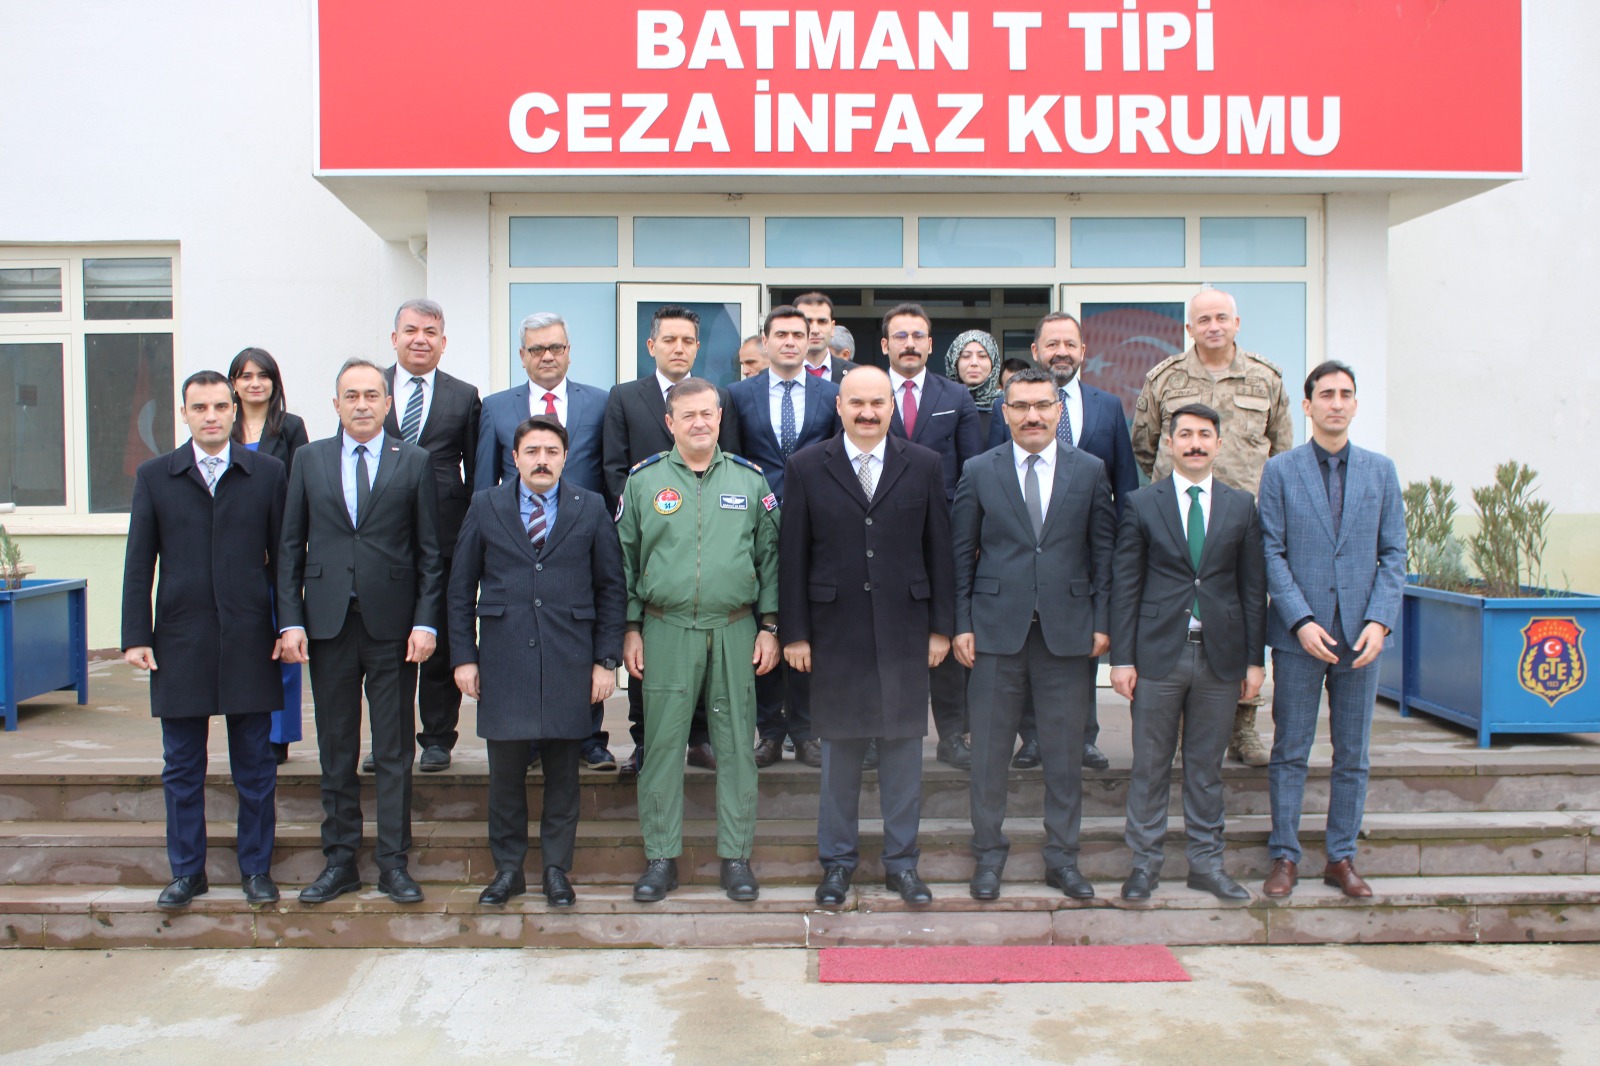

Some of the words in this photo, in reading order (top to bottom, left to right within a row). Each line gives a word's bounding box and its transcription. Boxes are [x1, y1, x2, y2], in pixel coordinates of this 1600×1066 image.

[637, 9, 969, 71] BATMAN
[993, 11, 1042, 71] T
[1069, 0, 1215, 72] TİPİ
[508, 92, 731, 154] CEZA
[754, 79, 985, 153] İNFAZ
[1008, 94, 1341, 156] KURUMU
